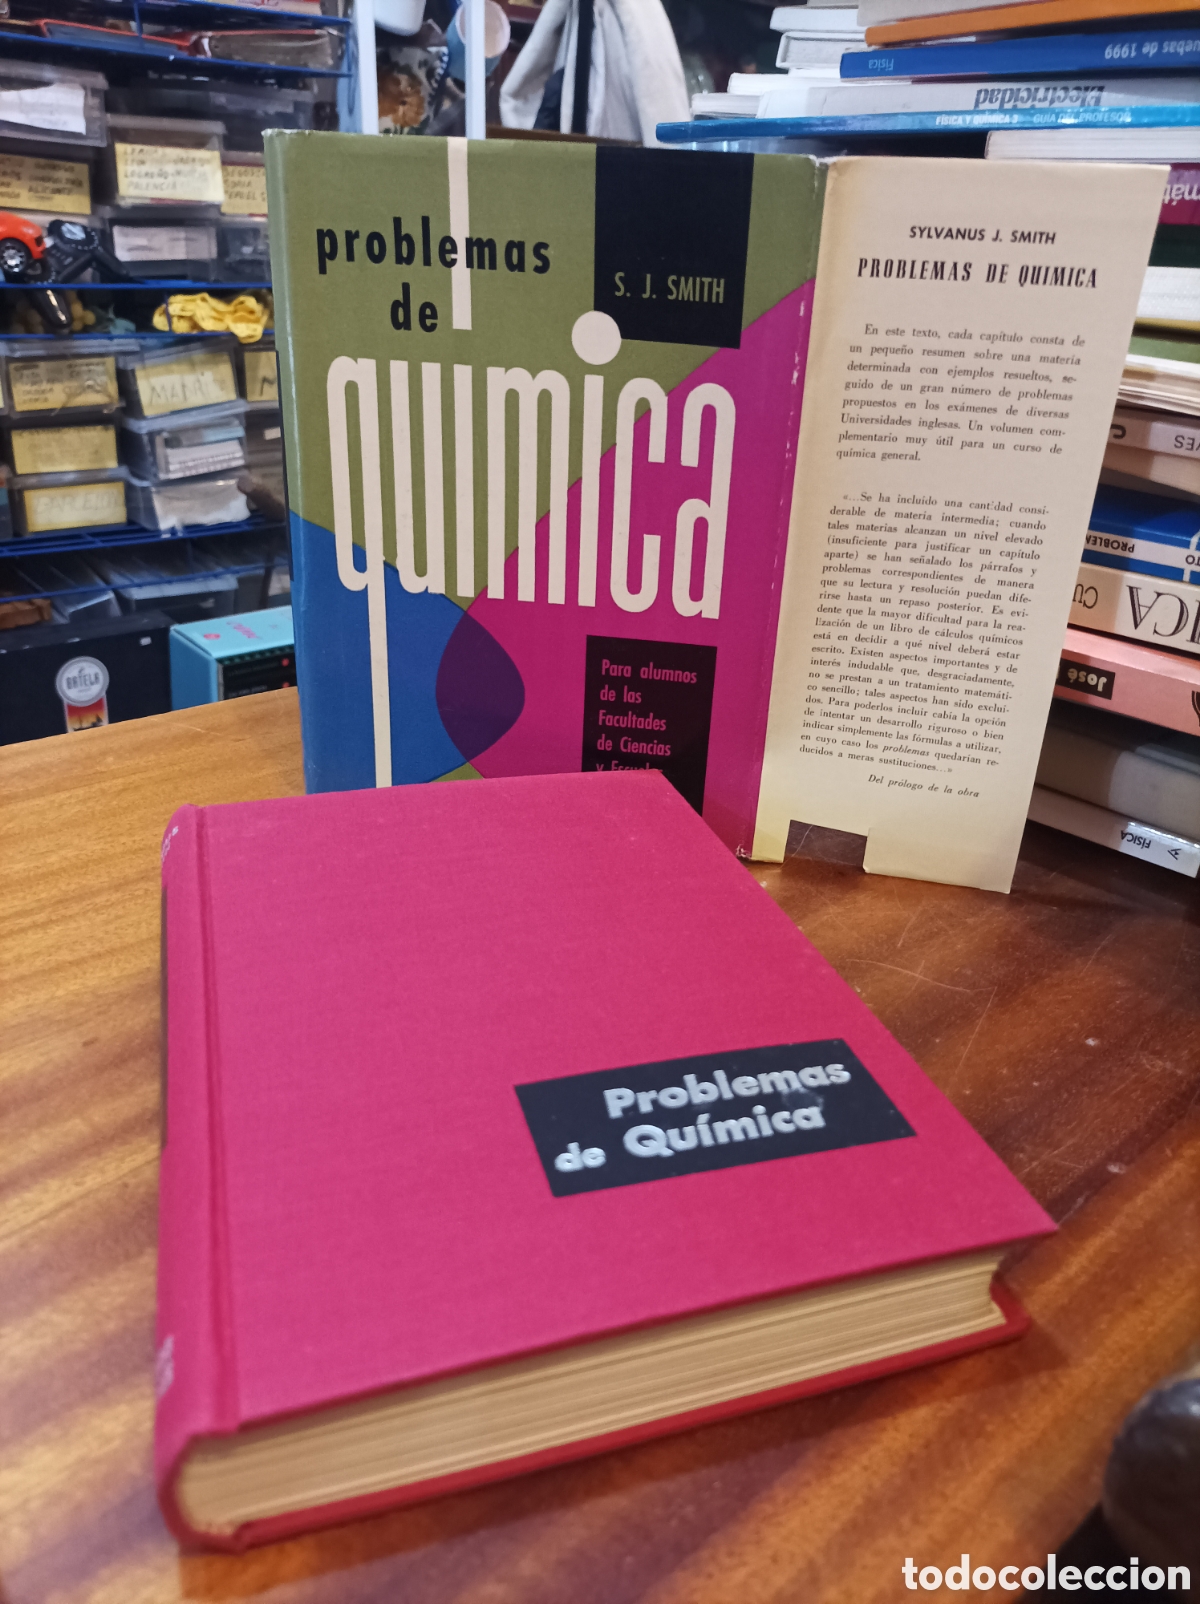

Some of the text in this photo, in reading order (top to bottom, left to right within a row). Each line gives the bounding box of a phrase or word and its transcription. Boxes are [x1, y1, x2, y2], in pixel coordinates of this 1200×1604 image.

[1104, 43, 1137, 59] 1999
[1142, 42, 1158, 58] de
[868, 58, 894, 71] Física
[974, 86, 1105, 110] Electricidad
[316, 216, 551, 275] problemas
[909, 225, 1056, 245] SYLVANUS J. SMITH
[857, 257, 1097, 289] PROBLEMAS DE QUIMICA
[614, 272, 726, 304] S. J. SMITH
[390, 282, 439, 332] de
[864, 323, 879, 335] En
[885, 327, 906, 337] este
[947, 328, 973, 340] cada
[979, 331, 1024, 345] capítulo
[1029, 336, 1065, 346] consta
[1071, 334, 1086, 347] de
[849, 344, 1082, 366] un pequeño resumen sobre una materia
[846, 360, 911, 373] determinada
[919, 367, 939, 375] con
[946, 365, 995, 380] ejemplos
[844, 378, 1073, 401] guido de un gran número de problemas
[842, 398, 897, 410] propuestos
[924, 399, 940, 411] los
[946, 402, 998, 415] exámenes
[1005, 404, 1019, 416] de
[1026, 406, 1070, 419] diversas
[840, 412, 912, 427] Universidades
[968, 419, 983, 431] Un
[990, 422, 1034, 435] volumen
[835, 447, 876, 460] química
[838, 430, 898, 443] plementario
[905, 436, 928, 447] muy
[960, 440, 985, 450] para
[992, 442, 1005, 450] un
[1012, 444, 1042, 453] curso
[1049, 443, 1063, 455] de
[829, 505, 866, 517] derable
[873, 508, 887, 518] de
[894, 511, 932, 521] materia
[1009, 520, 1047, 530] cuando
[827, 520, 1044, 546] tales materias alcanzan un nivel elevado
[821, 563, 1035, 590] problemas correspondientes de manera
[602, 659, 698, 684] Para alumnos
[810, 656, 841, 667] interés
[847, 659, 894, 673] indudable
[850, 646, 884, 658] Existen
[889, 653, 928, 663] aspectos
[933, 655, 990, 670] importantes
[994, 665, 1001, 674] y
[1006, 663, 1018, 674] de
[838, 674, 873, 688] prestan
[888, 679, 900, 687] un
[905, 680, 960, 694] tratamiento
[1067, 668, 1107, 692] José
[600, 684, 642, 703] de las
[598, 709, 667, 731] Facultades
[803, 707, 815, 716] de
[819, 708, 855, 721] intentar
[876, 715, 923, 729] desarrollo
[927, 722, 967, 735] riguroso
[983, 729, 1004, 741] bien
[597, 733, 671, 756] de Ciencias
[802, 719, 835, 731] indicar
[837, 724, 893, 739] simplemente
[895, 730, 909, 741] las
[911, 733, 953, 747] fórmulas
[867, 773, 980, 798] Del prólogo de la obra
[1121, 830, 1152, 849] FÍSICA
[603, 1062, 851, 1119] Problemas
[554, 1104, 826, 1172] de Química
